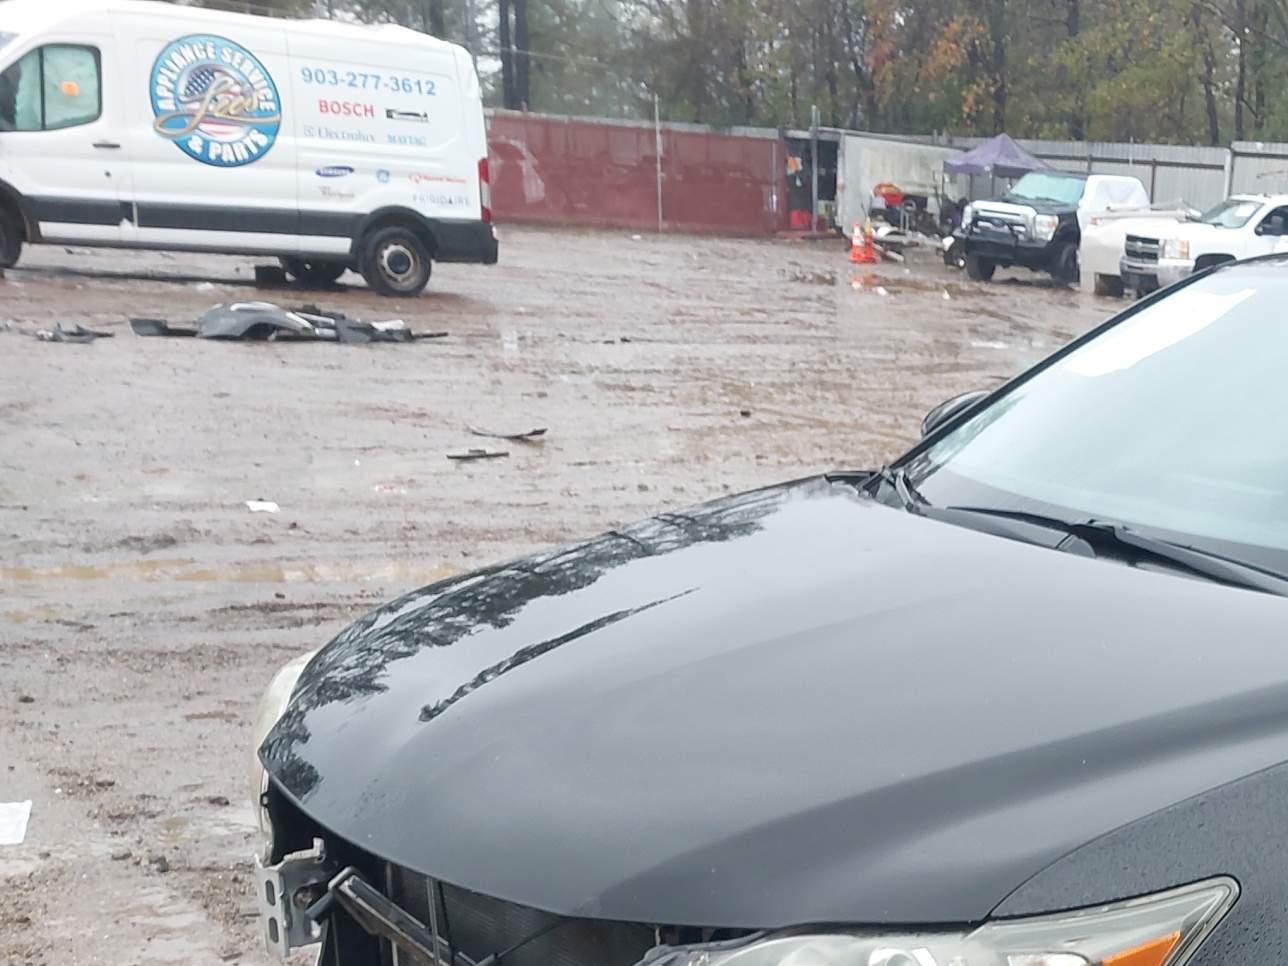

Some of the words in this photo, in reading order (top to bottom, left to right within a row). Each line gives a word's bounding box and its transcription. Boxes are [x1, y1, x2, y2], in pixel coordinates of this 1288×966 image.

[156, 41, 216, 111] APPLIANCE
[219, 46, 276, 112] SERVICE
[301, 67, 437, 96] 903-277-3612
[318, 99, 375, 118] BOSCH
[208, 129, 269, 164] PARTS
